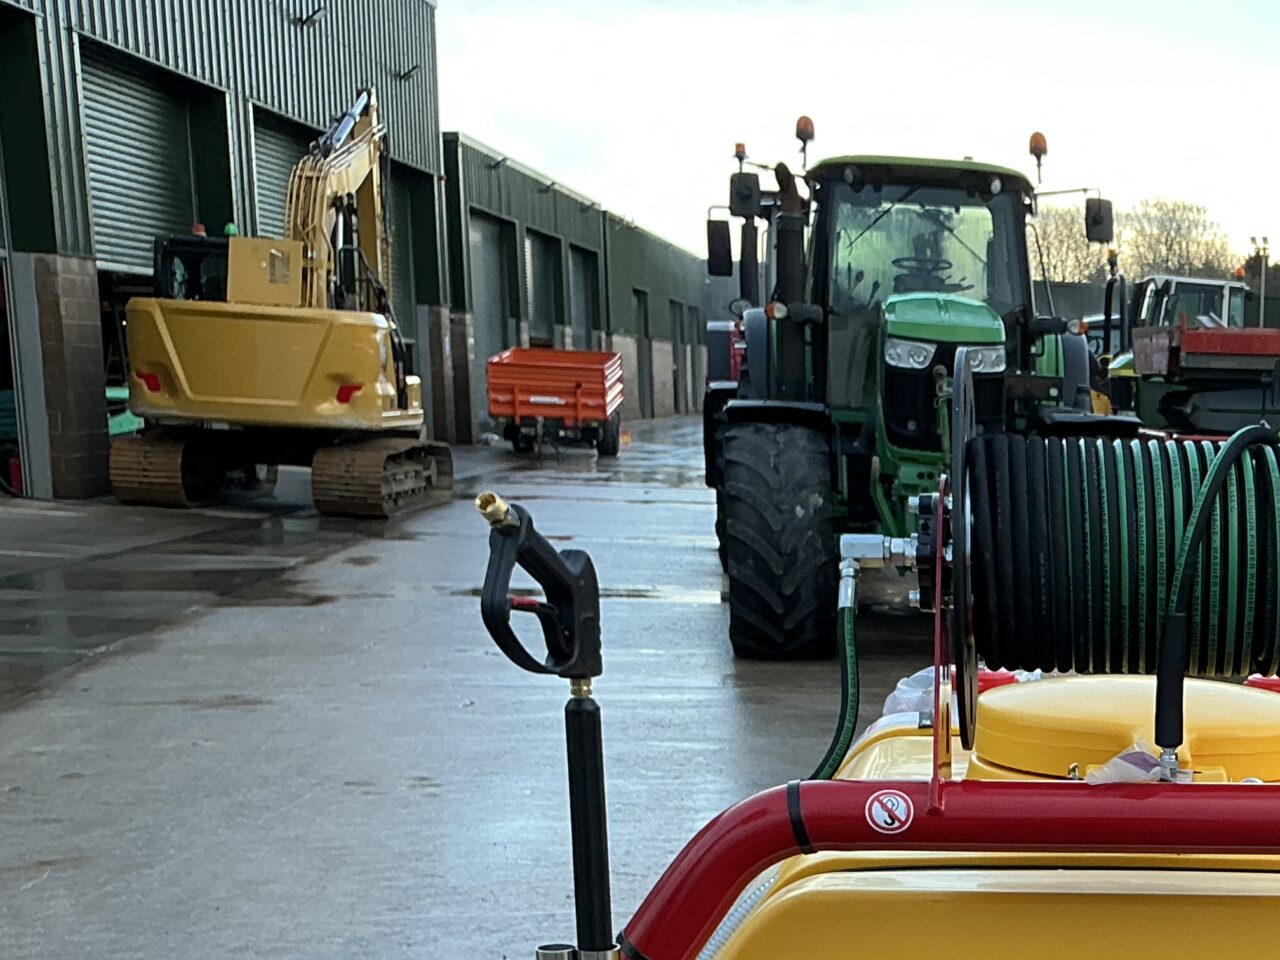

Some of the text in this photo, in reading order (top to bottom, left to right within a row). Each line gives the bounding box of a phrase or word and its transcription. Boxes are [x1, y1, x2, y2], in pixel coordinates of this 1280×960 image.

[1246, 487, 1256, 531] BRENDON
[1138, 516, 1146, 556] WASHER
[1157, 518, 1165, 559] WASHER
[1247, 534, 1256, 569] POWER
[1157, 562, 1165, 586] HOSE
[1210, 546, 1219, 588] WASHER
[1246, 572, 1256, 613] WASHER
[846, 690, 858, 724] POWER
